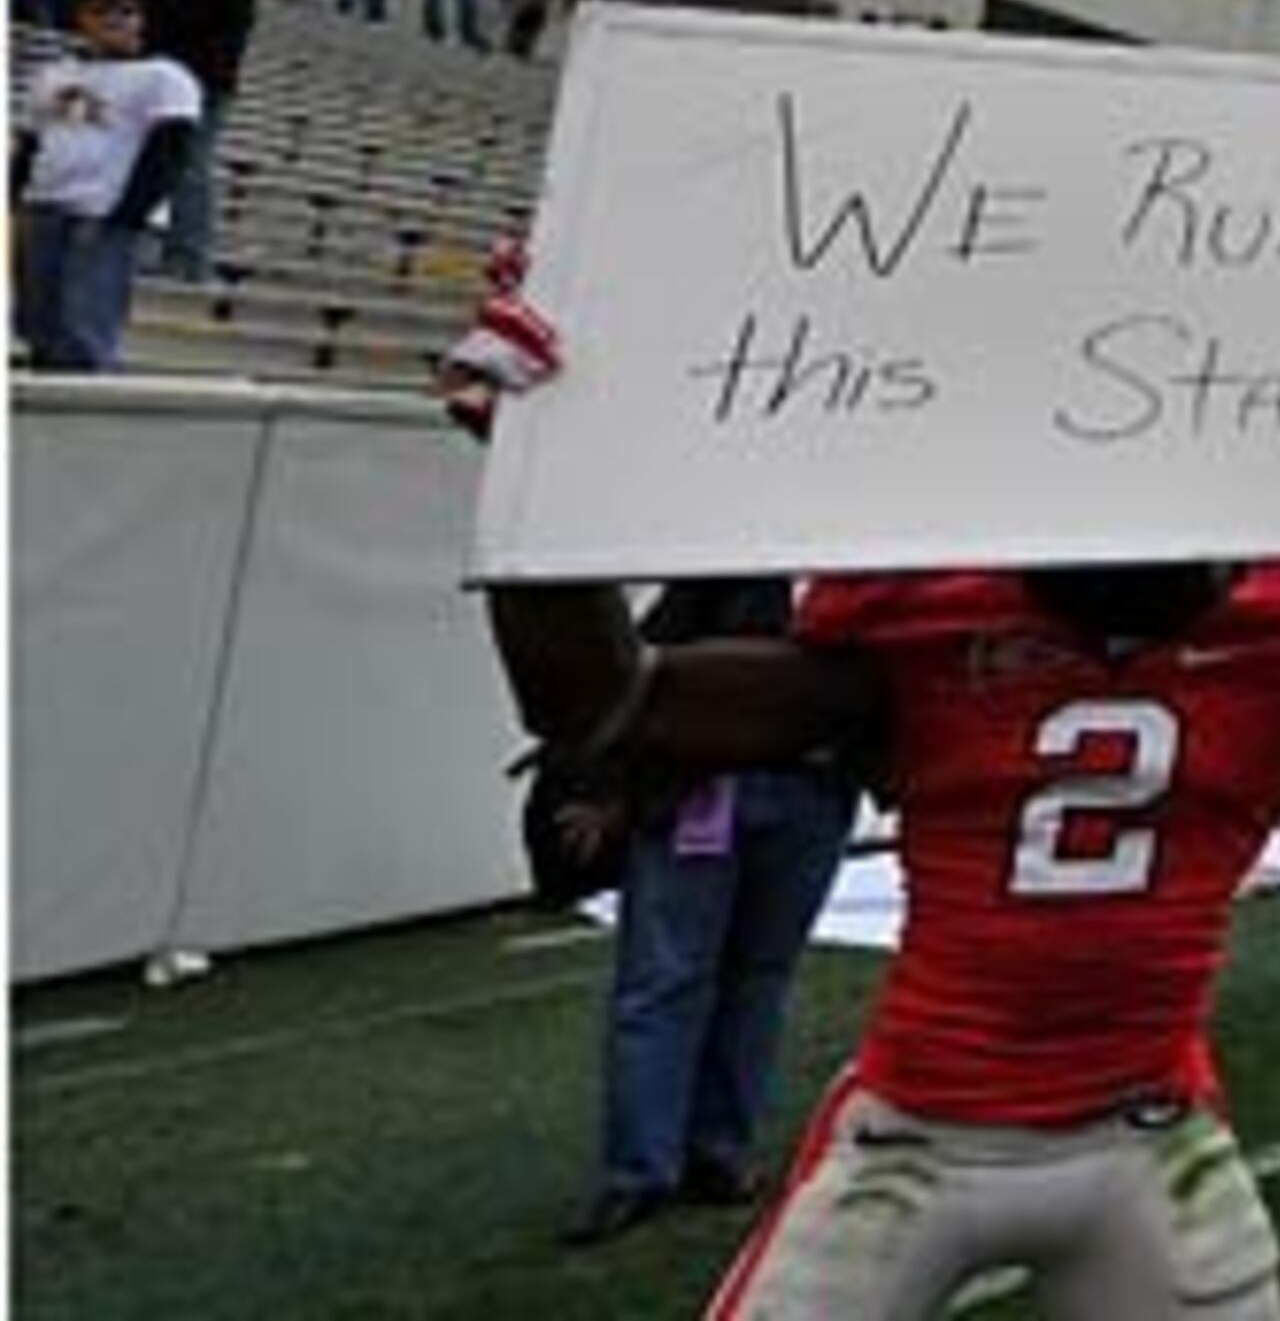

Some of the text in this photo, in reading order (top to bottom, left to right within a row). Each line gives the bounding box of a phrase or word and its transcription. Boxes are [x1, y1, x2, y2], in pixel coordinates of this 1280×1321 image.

[776, 91, 1050, 278] WE
[686, 313, 937, 423] this
[1006, 697, 1180, 895] 2
